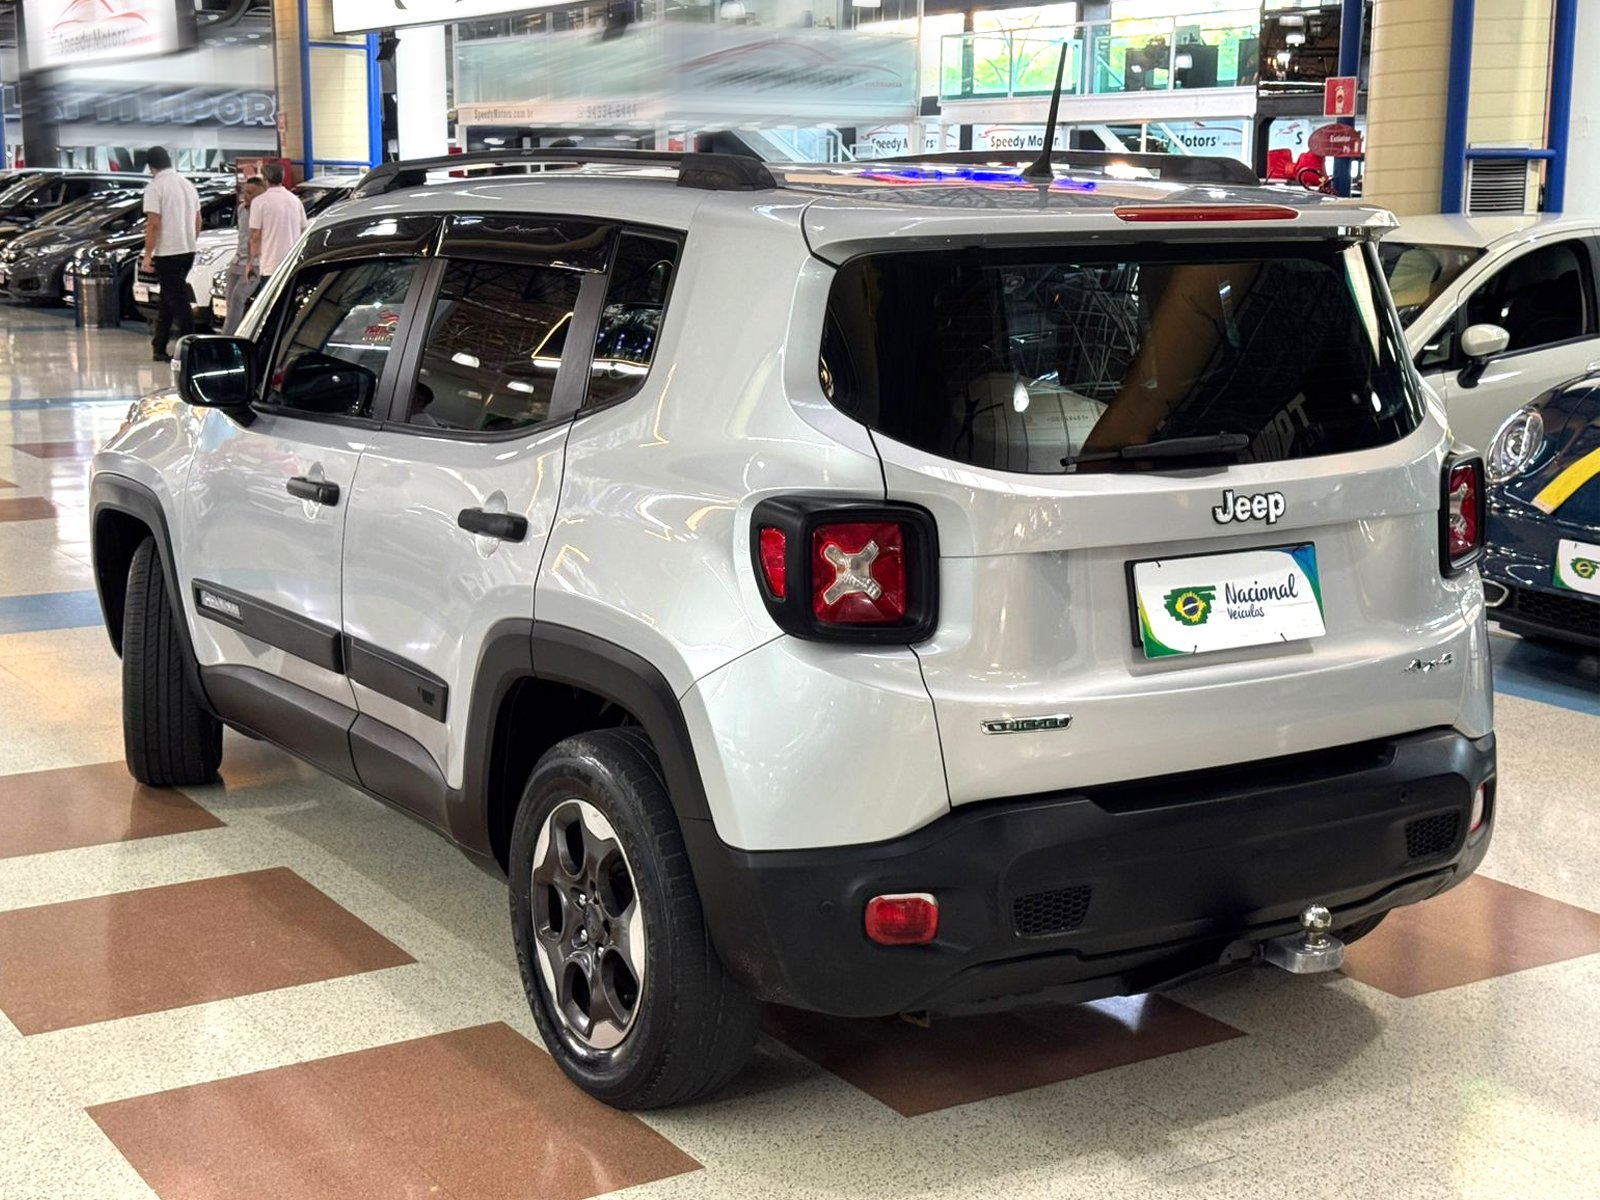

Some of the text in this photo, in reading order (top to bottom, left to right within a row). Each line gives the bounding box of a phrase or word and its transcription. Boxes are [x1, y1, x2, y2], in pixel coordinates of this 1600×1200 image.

[871, 138, 902, 152] Speedy
[990, 135, 1061, 149] Speedy Mor
[1212, 489, 1286, 525] Jeep
[1224, 573, 1298, 605] Nacional
